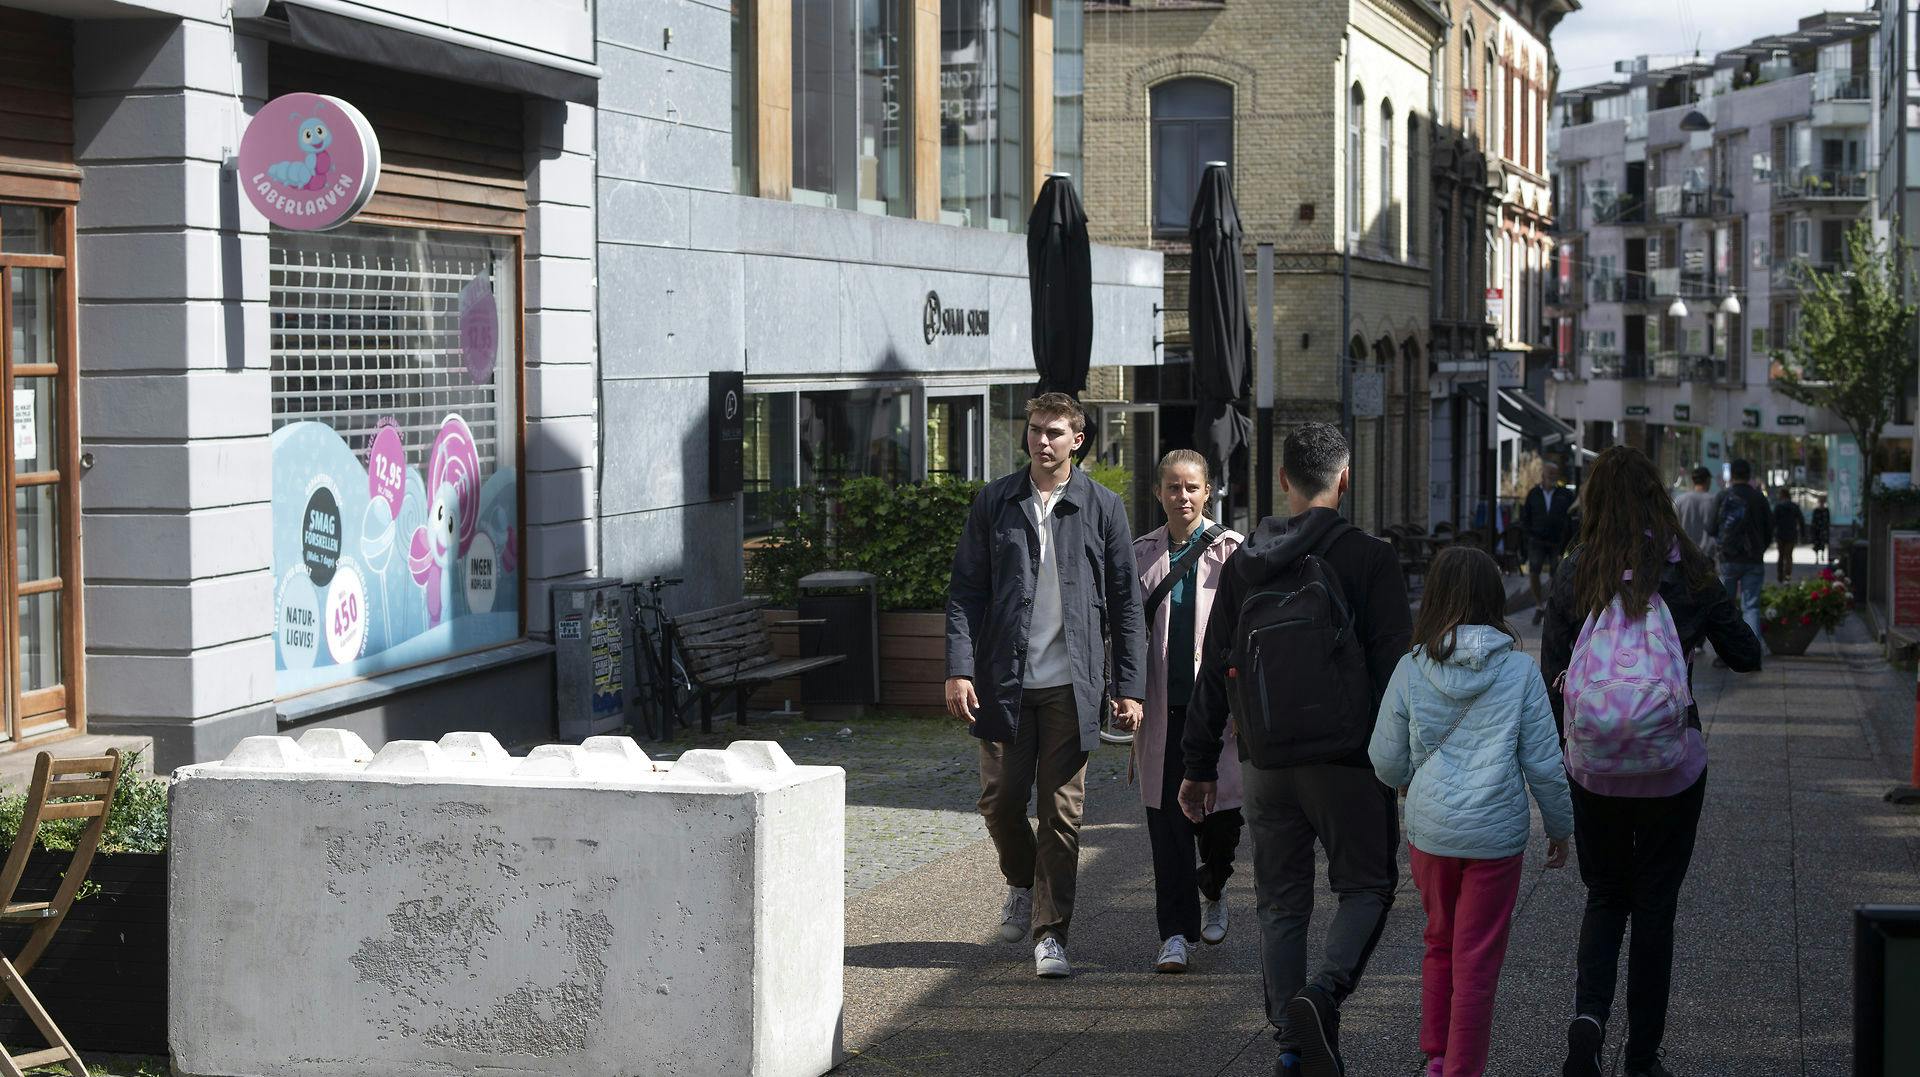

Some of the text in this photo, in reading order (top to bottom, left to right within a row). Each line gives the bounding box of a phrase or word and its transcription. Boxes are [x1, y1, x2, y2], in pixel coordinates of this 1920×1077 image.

[252, 173, 353, 216] LABERLARVEN
[375, 453, 402, 490] 12,95
[309, 509, 335, 534] SMAG
[304, 531, 338, 552] FORSKELLEN
[471, 558, 492, 576] INGEN
[286, 606, 315, 627] NATUR-
[334, 592, 357, 636] 450
[286, 629, 314, 648] LIGVIS!
